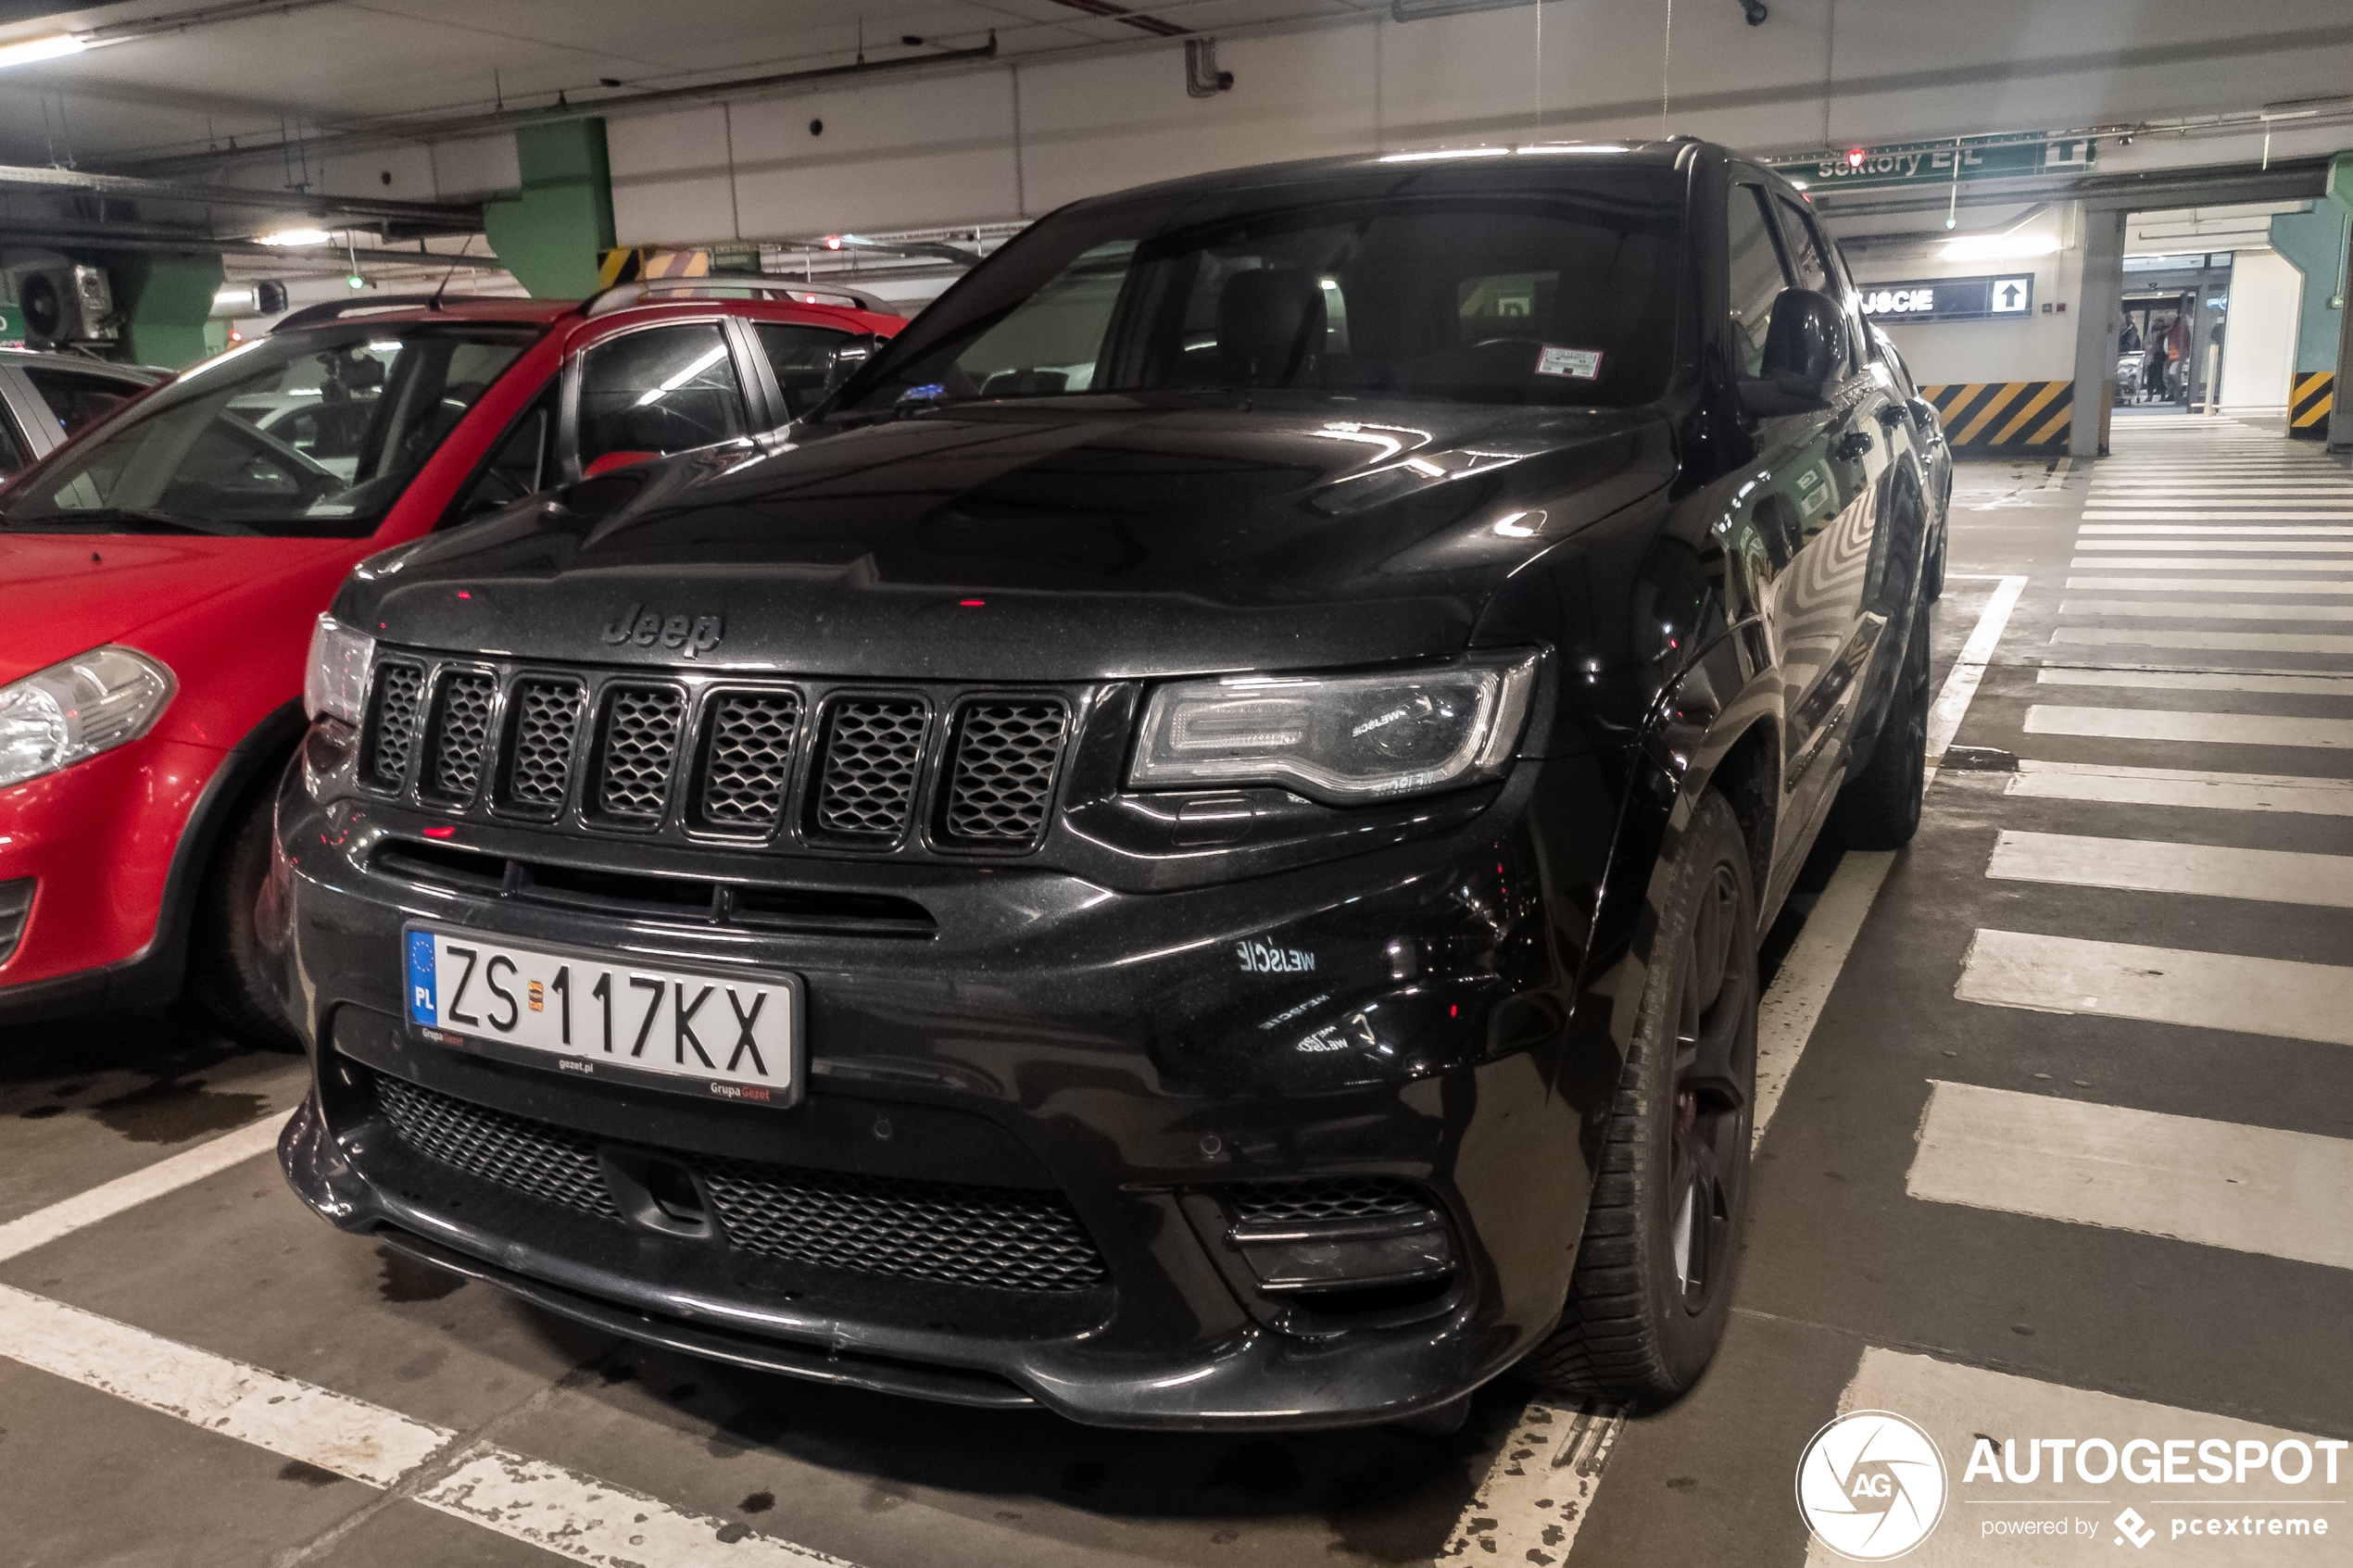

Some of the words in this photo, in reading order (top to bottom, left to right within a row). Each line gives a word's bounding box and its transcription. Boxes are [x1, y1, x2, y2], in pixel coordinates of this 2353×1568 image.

[603, 604, 725, 660] Jeep
[415, 985, 434, 1010] PL
[446, 945, 520, 1033] ZS
[550, 963, 770, 1076] 117KX
